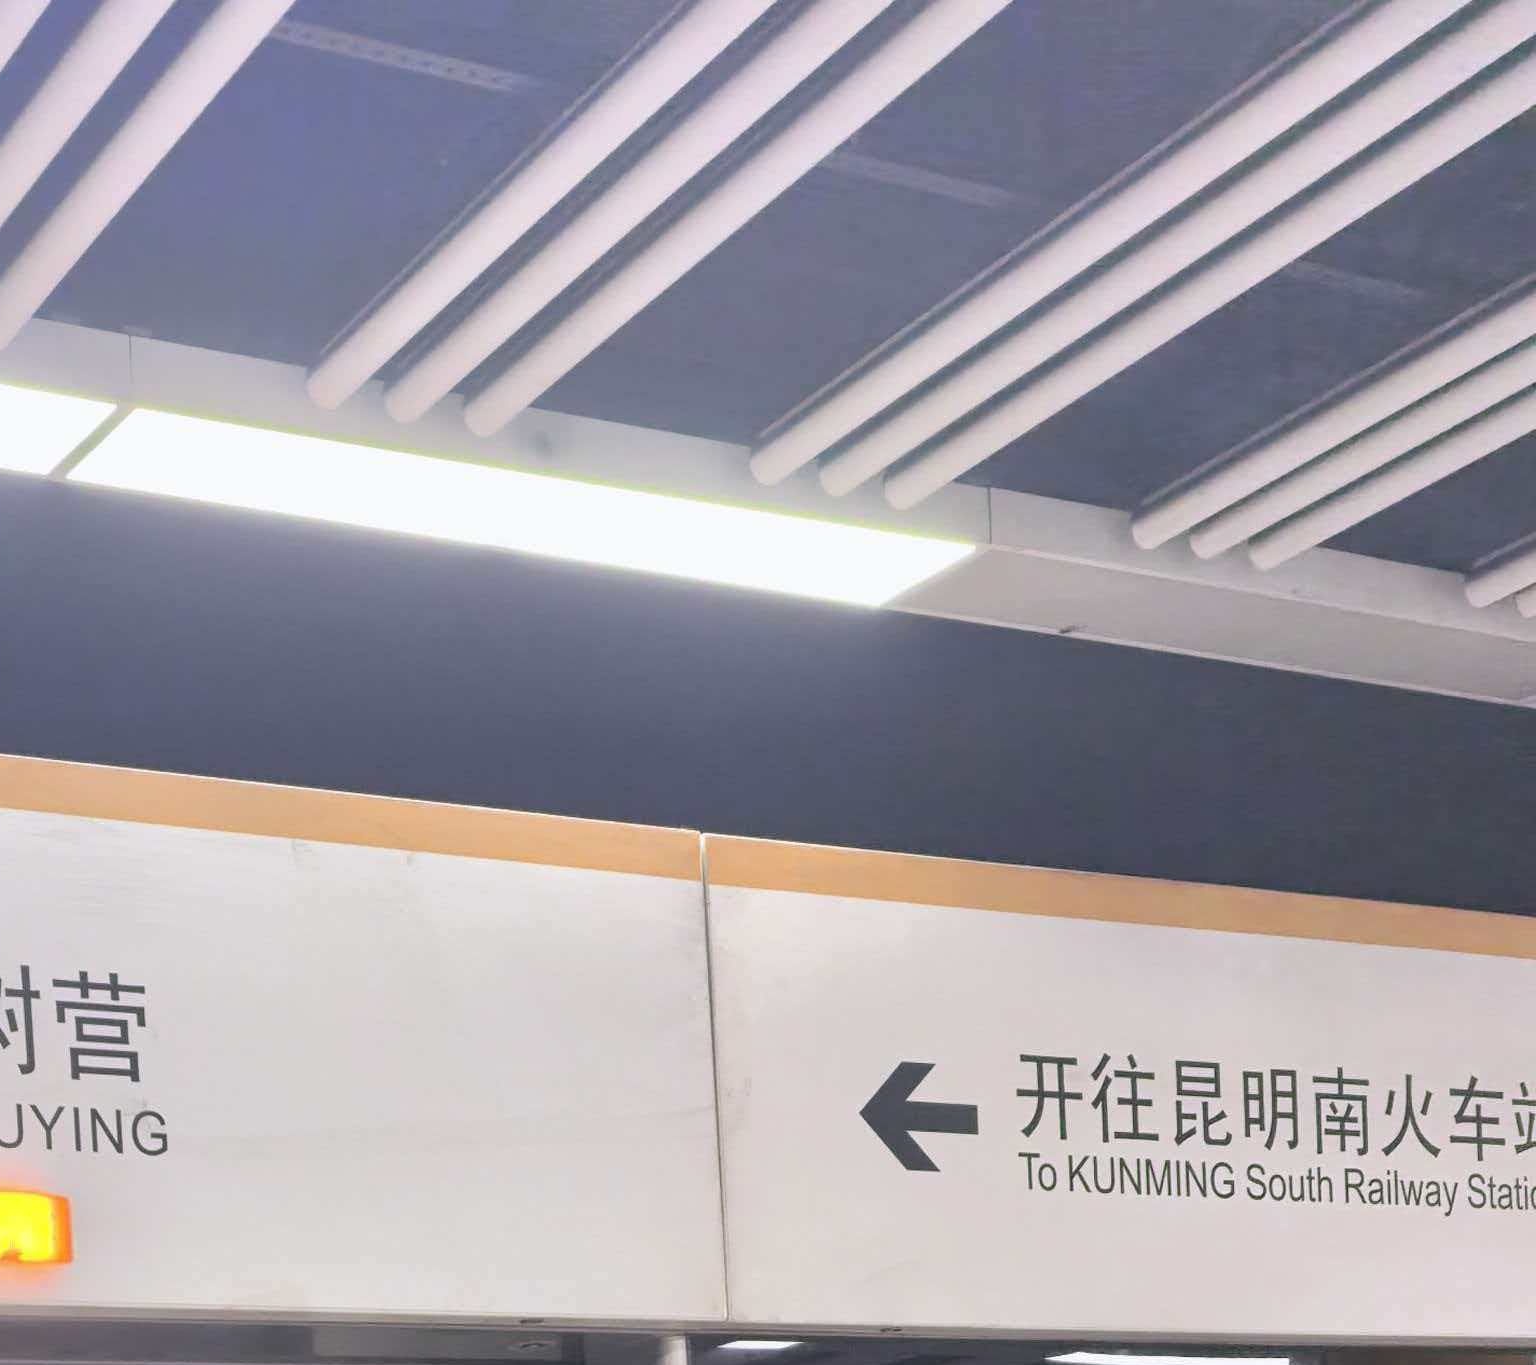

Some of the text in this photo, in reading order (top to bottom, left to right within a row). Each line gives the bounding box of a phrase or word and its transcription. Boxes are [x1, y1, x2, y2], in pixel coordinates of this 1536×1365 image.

[1017, 1152, 1058, 1192] To
[1068, 1155, 1236, 1200] KUNMING
[1246, 1165, 1335, 1206] South
[1344, 1168, 1459, 1217] Railway
